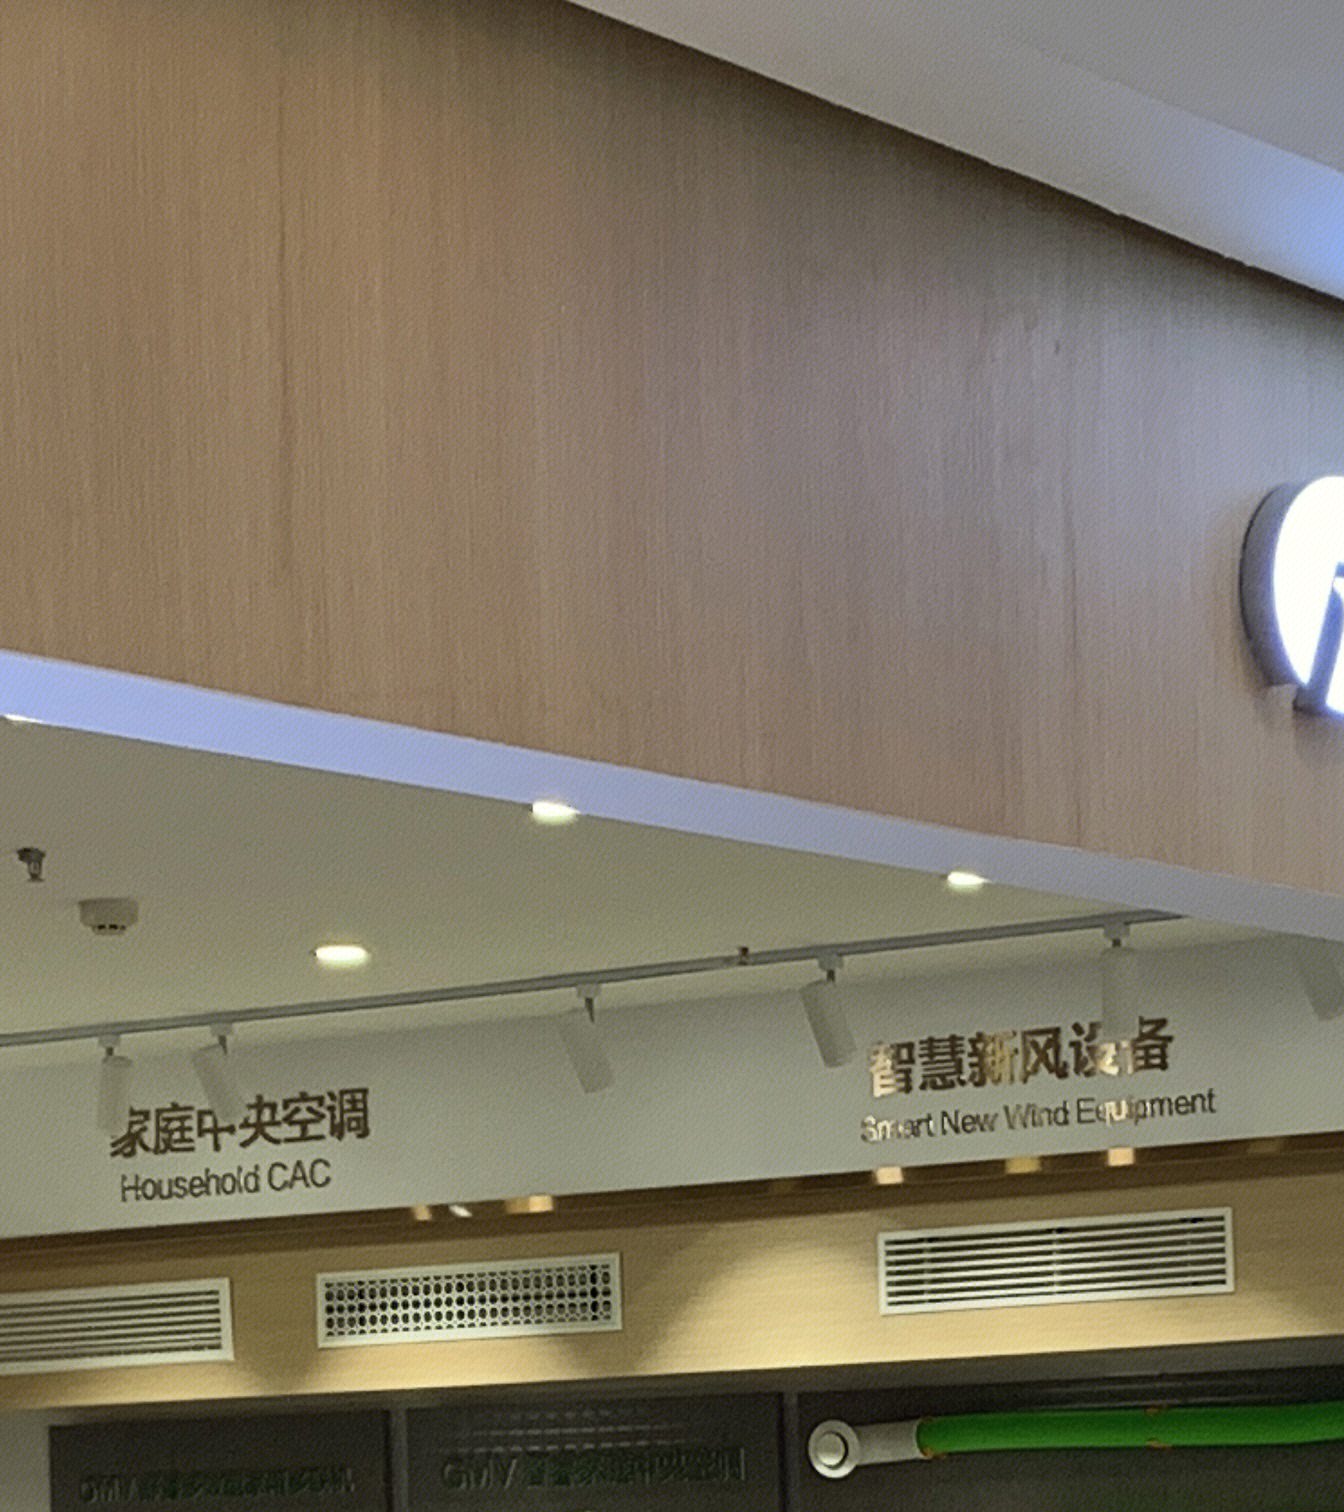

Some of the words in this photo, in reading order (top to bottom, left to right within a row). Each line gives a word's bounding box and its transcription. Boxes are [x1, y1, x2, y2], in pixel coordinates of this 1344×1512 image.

[861, 1112, 935, 1143] Smart
[941, 1108, 998, 1136] New
[1003, 1100, 1070, 1130] Wind
[1076, 1088, 1219, 1126] Equipment
[120, 1162, 261, 1202] Household
[267, 1158, 332, 1191] CAC
